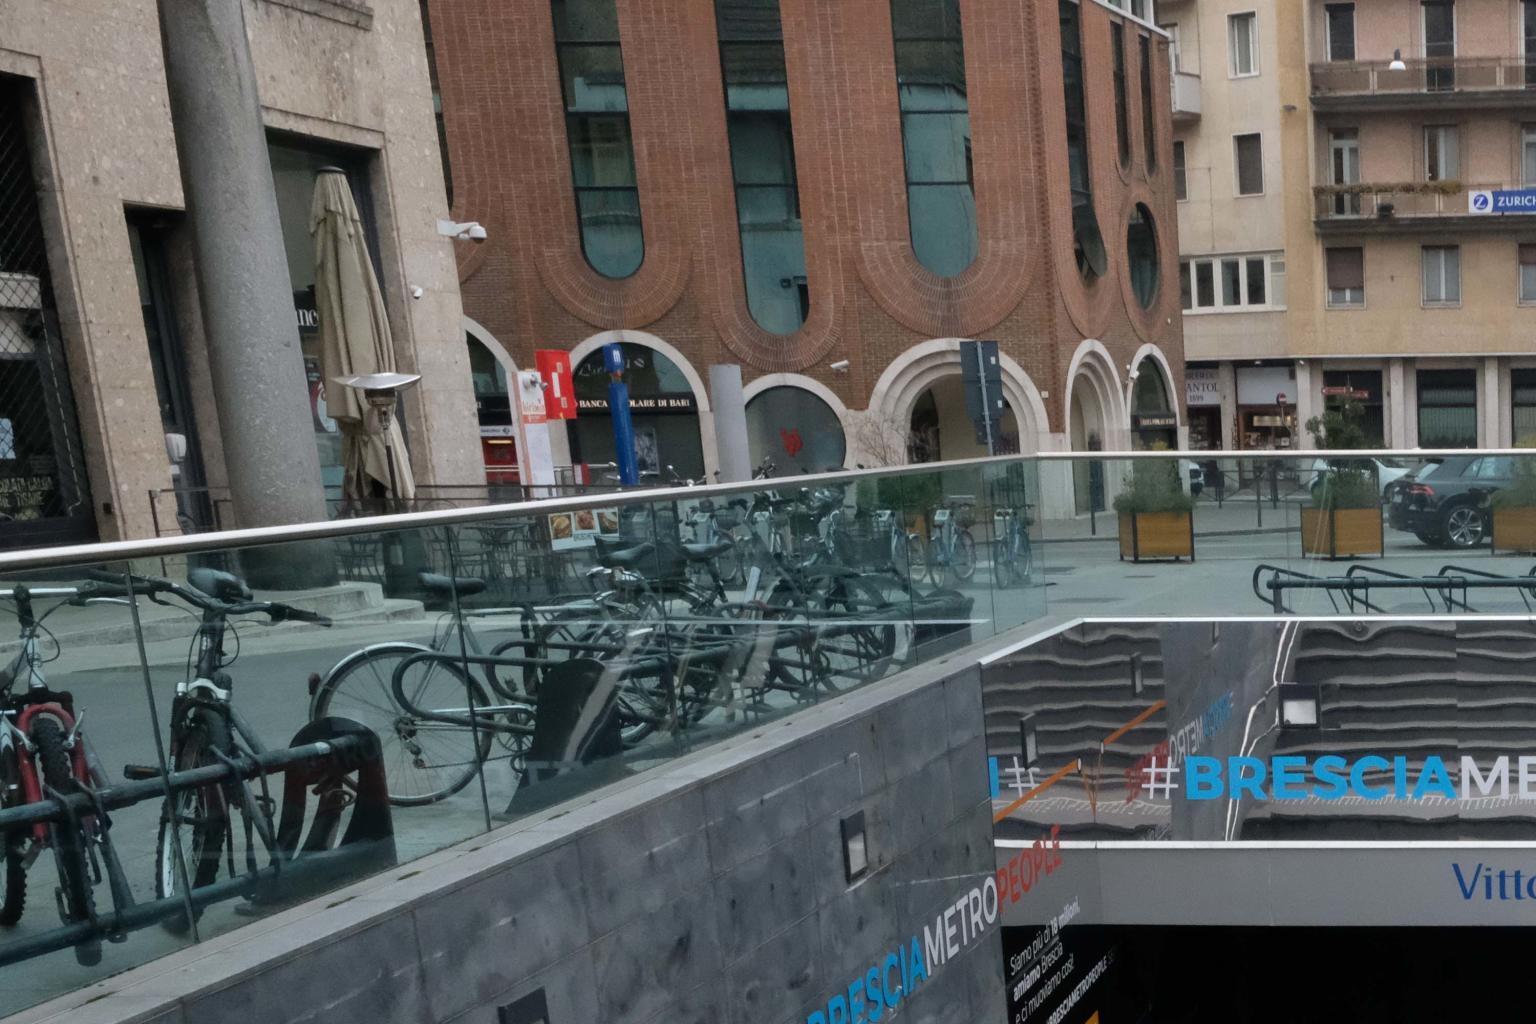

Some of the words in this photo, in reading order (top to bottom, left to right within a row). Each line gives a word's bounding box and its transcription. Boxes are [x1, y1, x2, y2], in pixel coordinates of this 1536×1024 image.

[579, 399, 608, 408] BANCA
[657, 399, 667, 407] DI
[669, 398, 690, 407] BARI
[1010, 945, 1032, 976] Siamo
[1013, 964, 1041, 1002] amiamo
[1041, 942, 1063, 974] Brescia
[1028, 971, 1061, 1015] muoviamo
